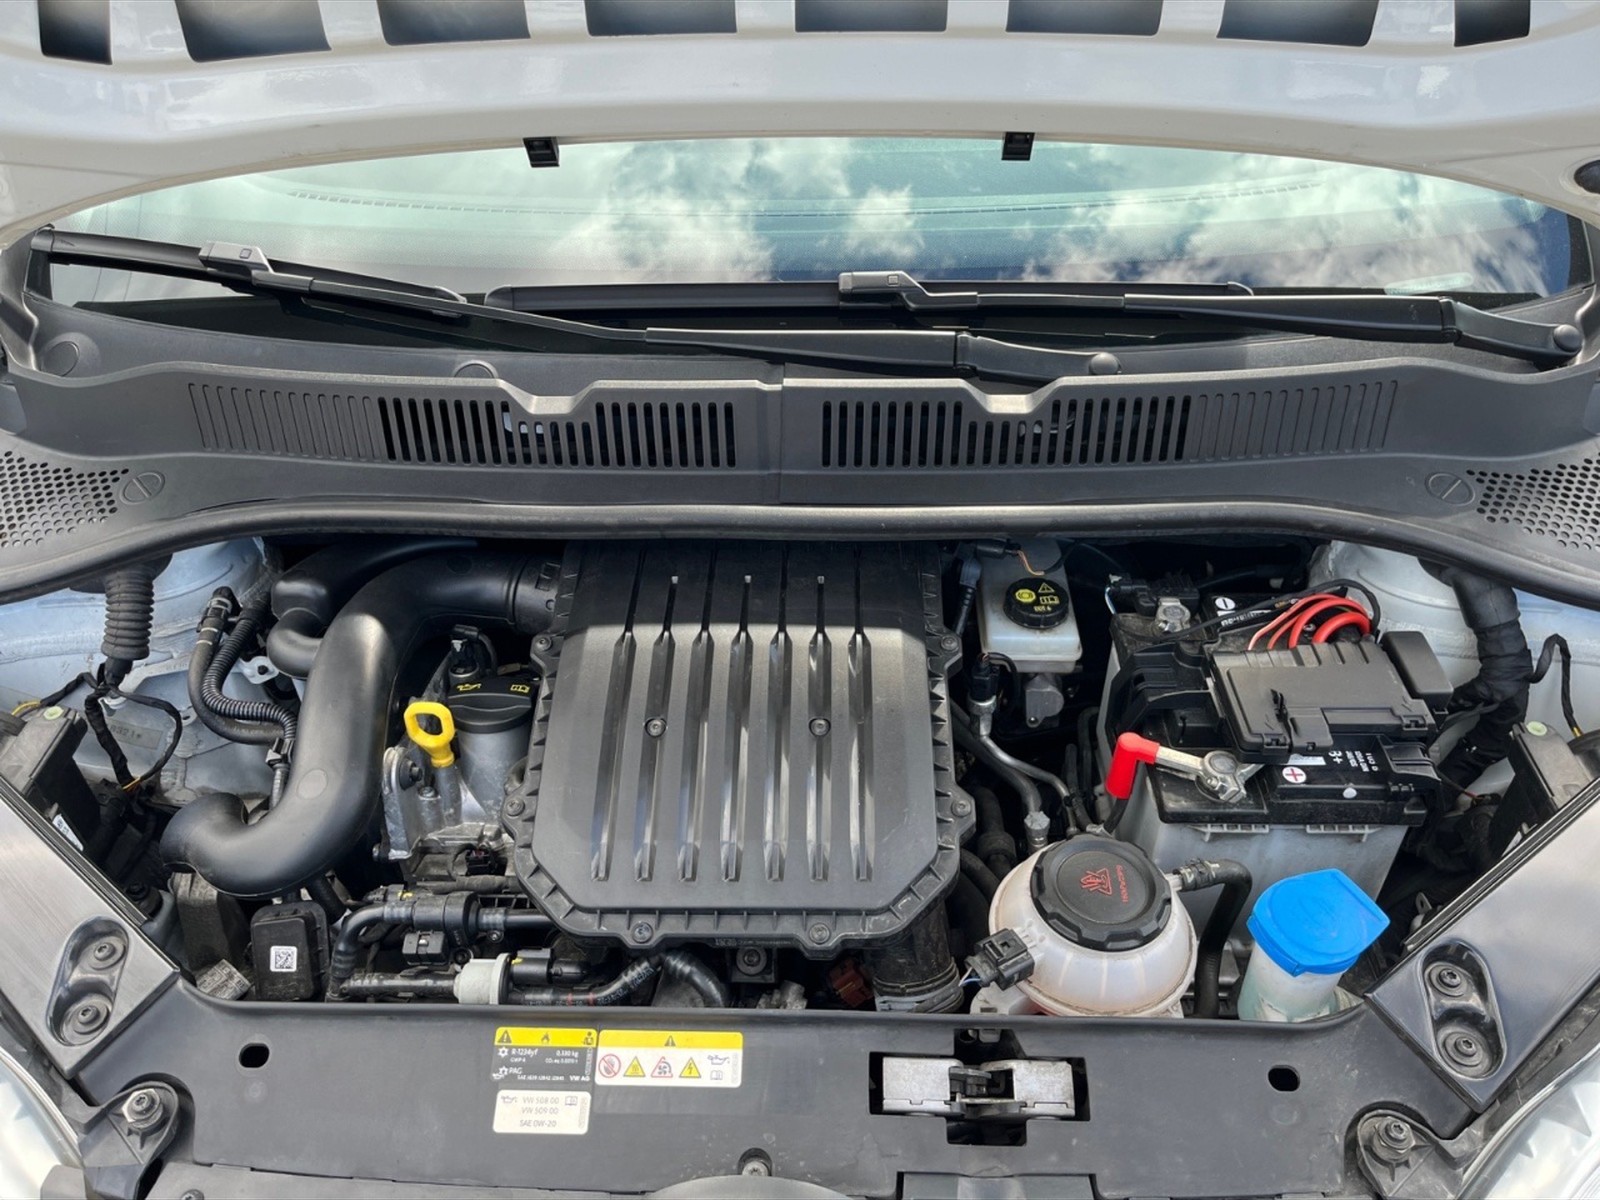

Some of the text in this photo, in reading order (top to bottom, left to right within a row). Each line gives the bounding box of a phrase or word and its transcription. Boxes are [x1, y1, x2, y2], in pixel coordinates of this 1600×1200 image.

[522, 1096, 560, 1105] VW 508 00
[535, 1107, 548, 1115] 509
[549, 1107, 560, 1115] 00
[519, 1119, 532, 1127] SAE
